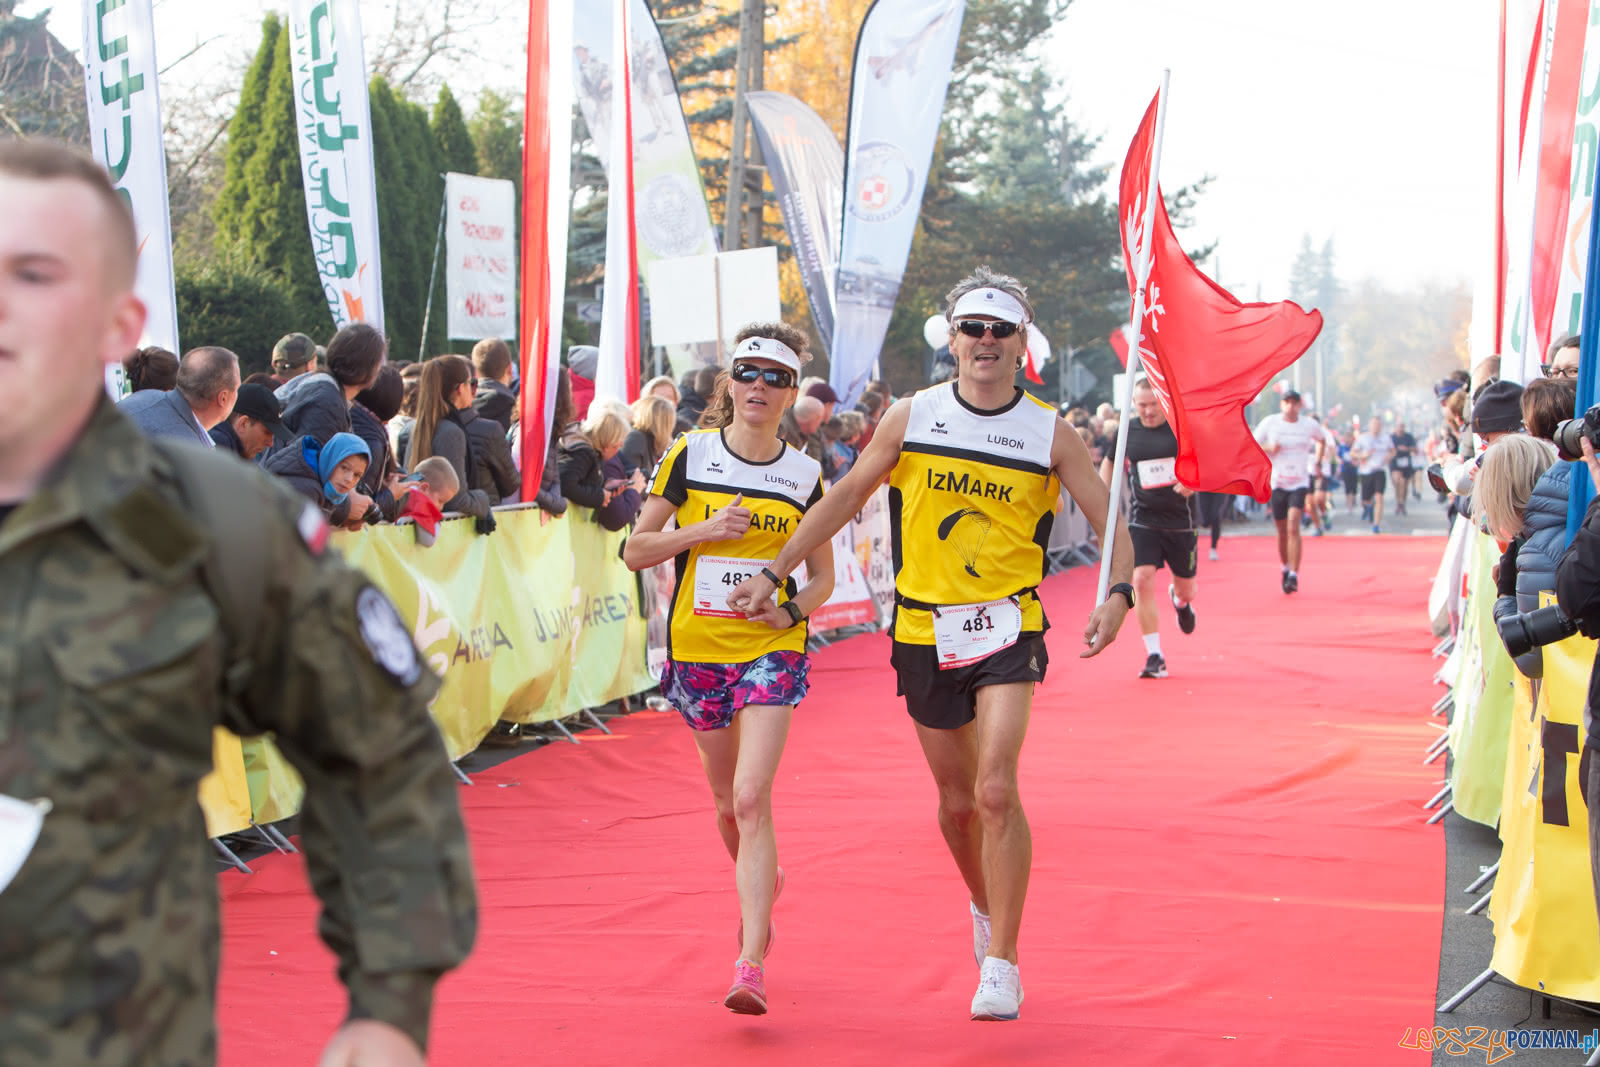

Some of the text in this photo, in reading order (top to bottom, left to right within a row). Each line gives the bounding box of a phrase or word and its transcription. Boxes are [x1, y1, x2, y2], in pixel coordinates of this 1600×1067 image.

[987, 433, 1025, 450] LUBOŃ
[764, 473, 799, 491] LUBOŃ
[962, 615, 995, 633] 481
